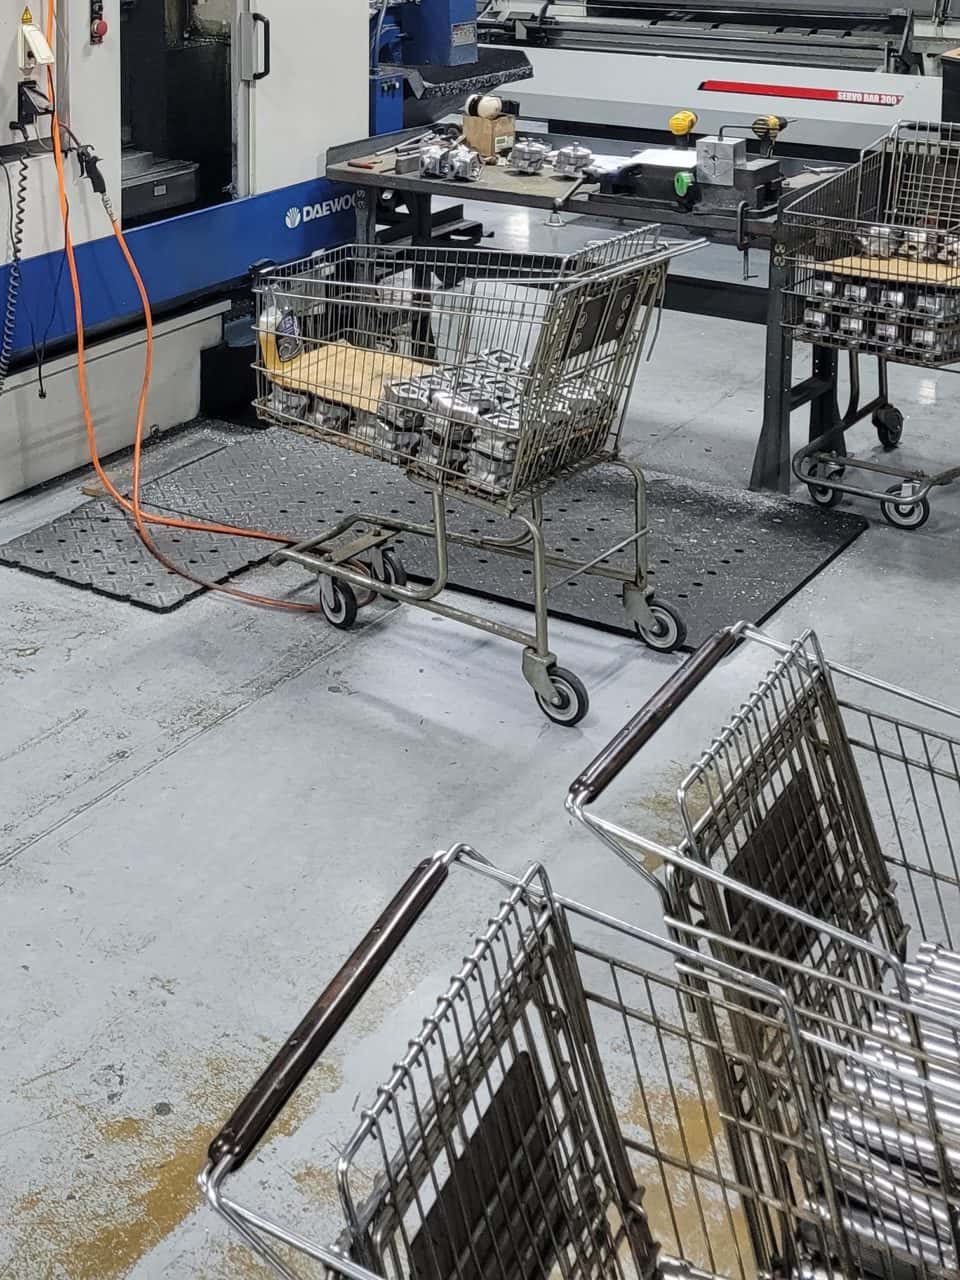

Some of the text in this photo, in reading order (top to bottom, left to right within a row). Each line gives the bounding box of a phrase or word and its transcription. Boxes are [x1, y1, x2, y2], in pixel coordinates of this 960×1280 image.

[837, 92, 897, 104] SERVO BAR 300
